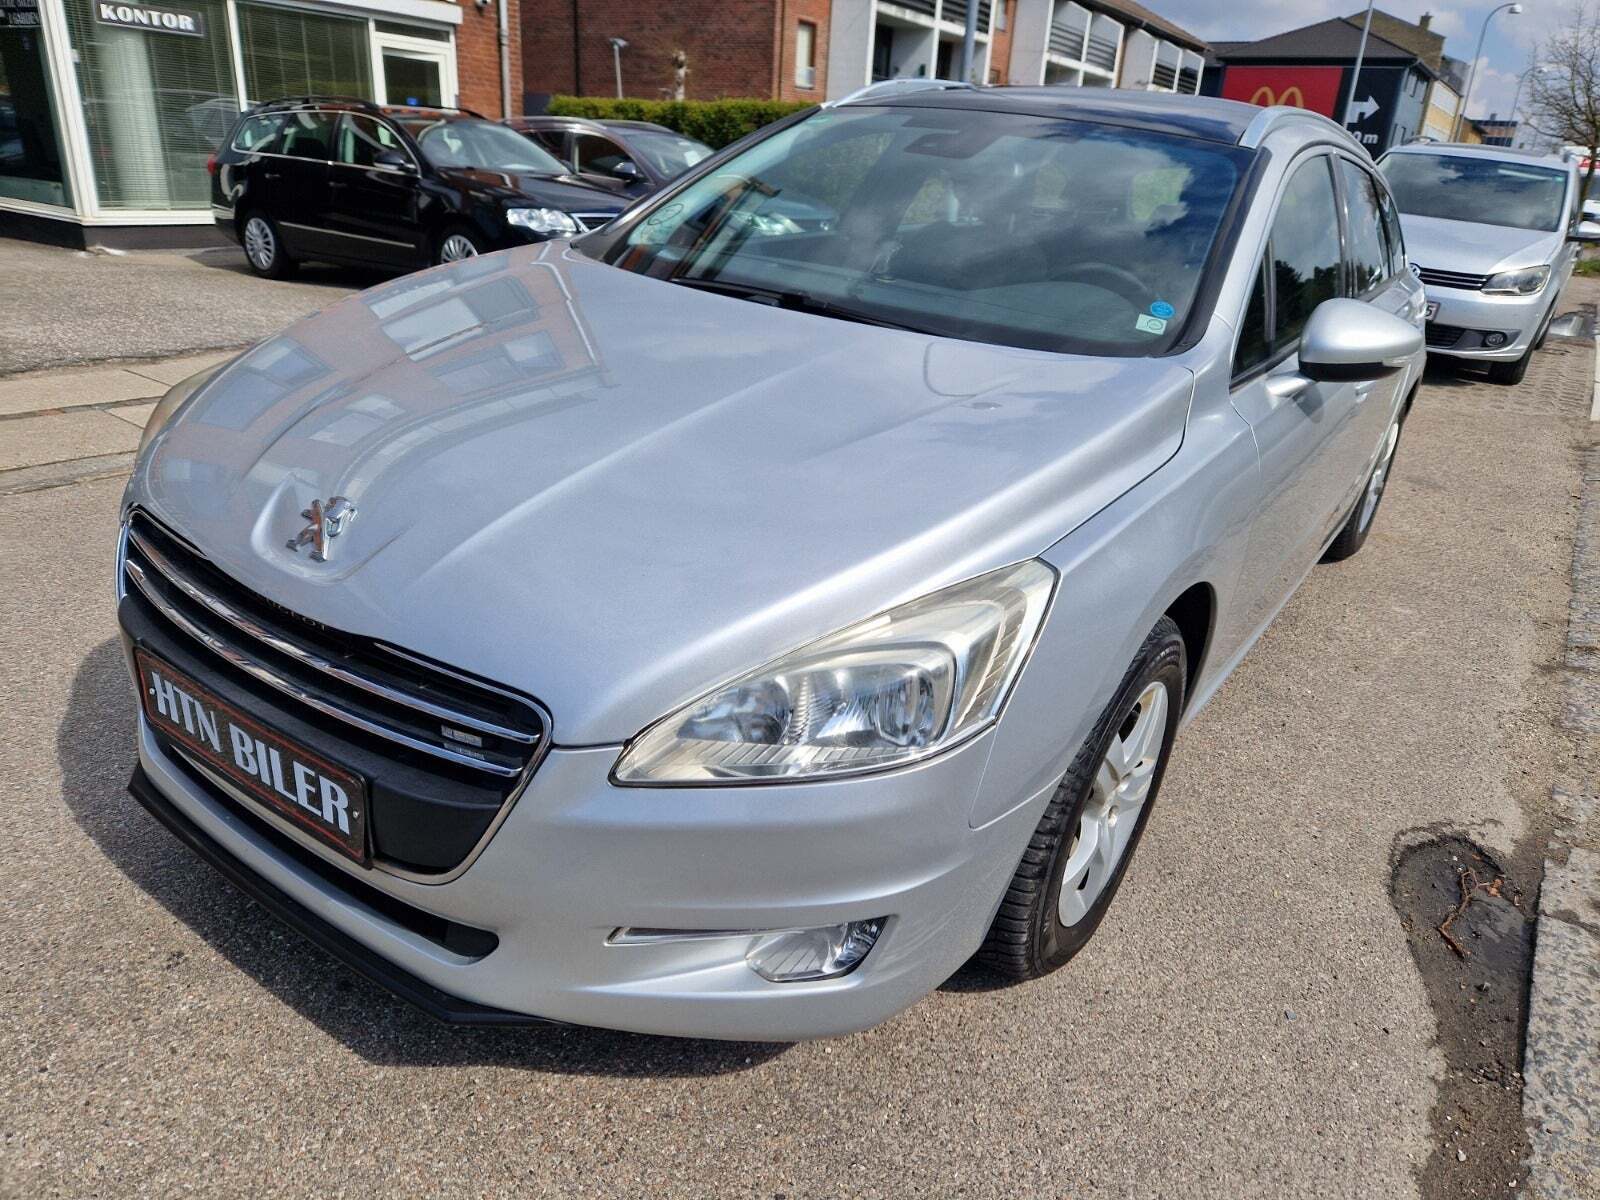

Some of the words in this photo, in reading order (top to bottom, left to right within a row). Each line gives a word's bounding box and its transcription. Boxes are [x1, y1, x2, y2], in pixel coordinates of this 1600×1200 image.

[100, 3, 194, 31] KONTOR
[152, 671, 221, 753] HTN
[229, 722, 350, 835] BILER
